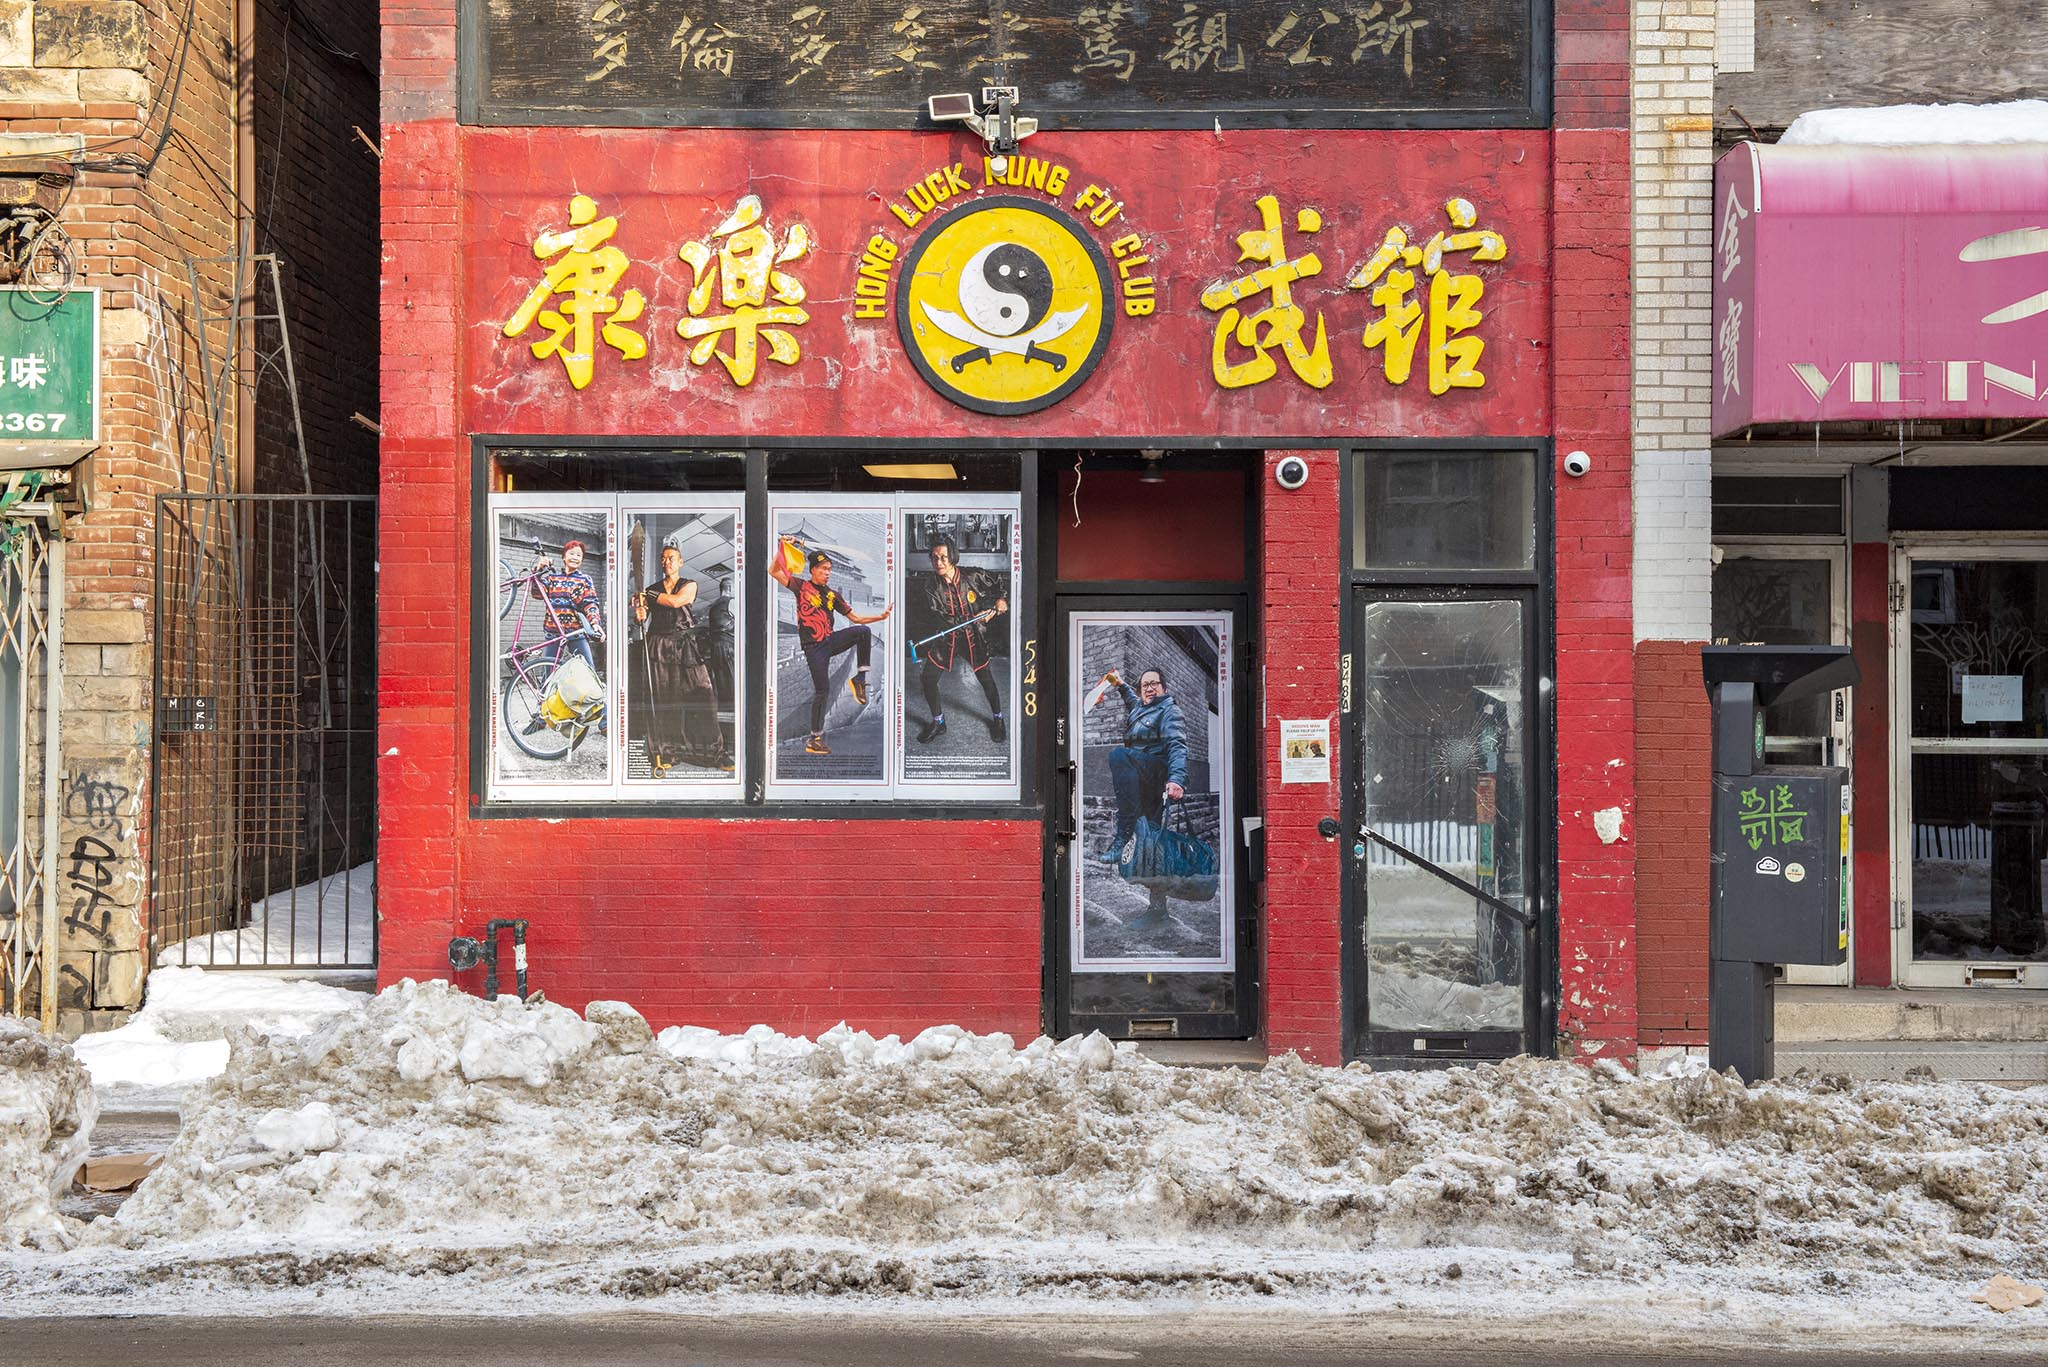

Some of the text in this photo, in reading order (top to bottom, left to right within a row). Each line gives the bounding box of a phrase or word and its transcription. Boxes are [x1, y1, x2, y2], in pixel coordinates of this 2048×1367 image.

[855, 234, 899, 319] HONG
[890, 162, 972, 228] LUCK
[1073, 184, 1121, 228] FU
[1111, 233, 1155, 317] CLUB
[0, 353, 47, 389] 味
[1787, 360, 2048, 403] VIETN
[0, 413, 67, 433] 367
[1023, 639, 1037, 717] 548
